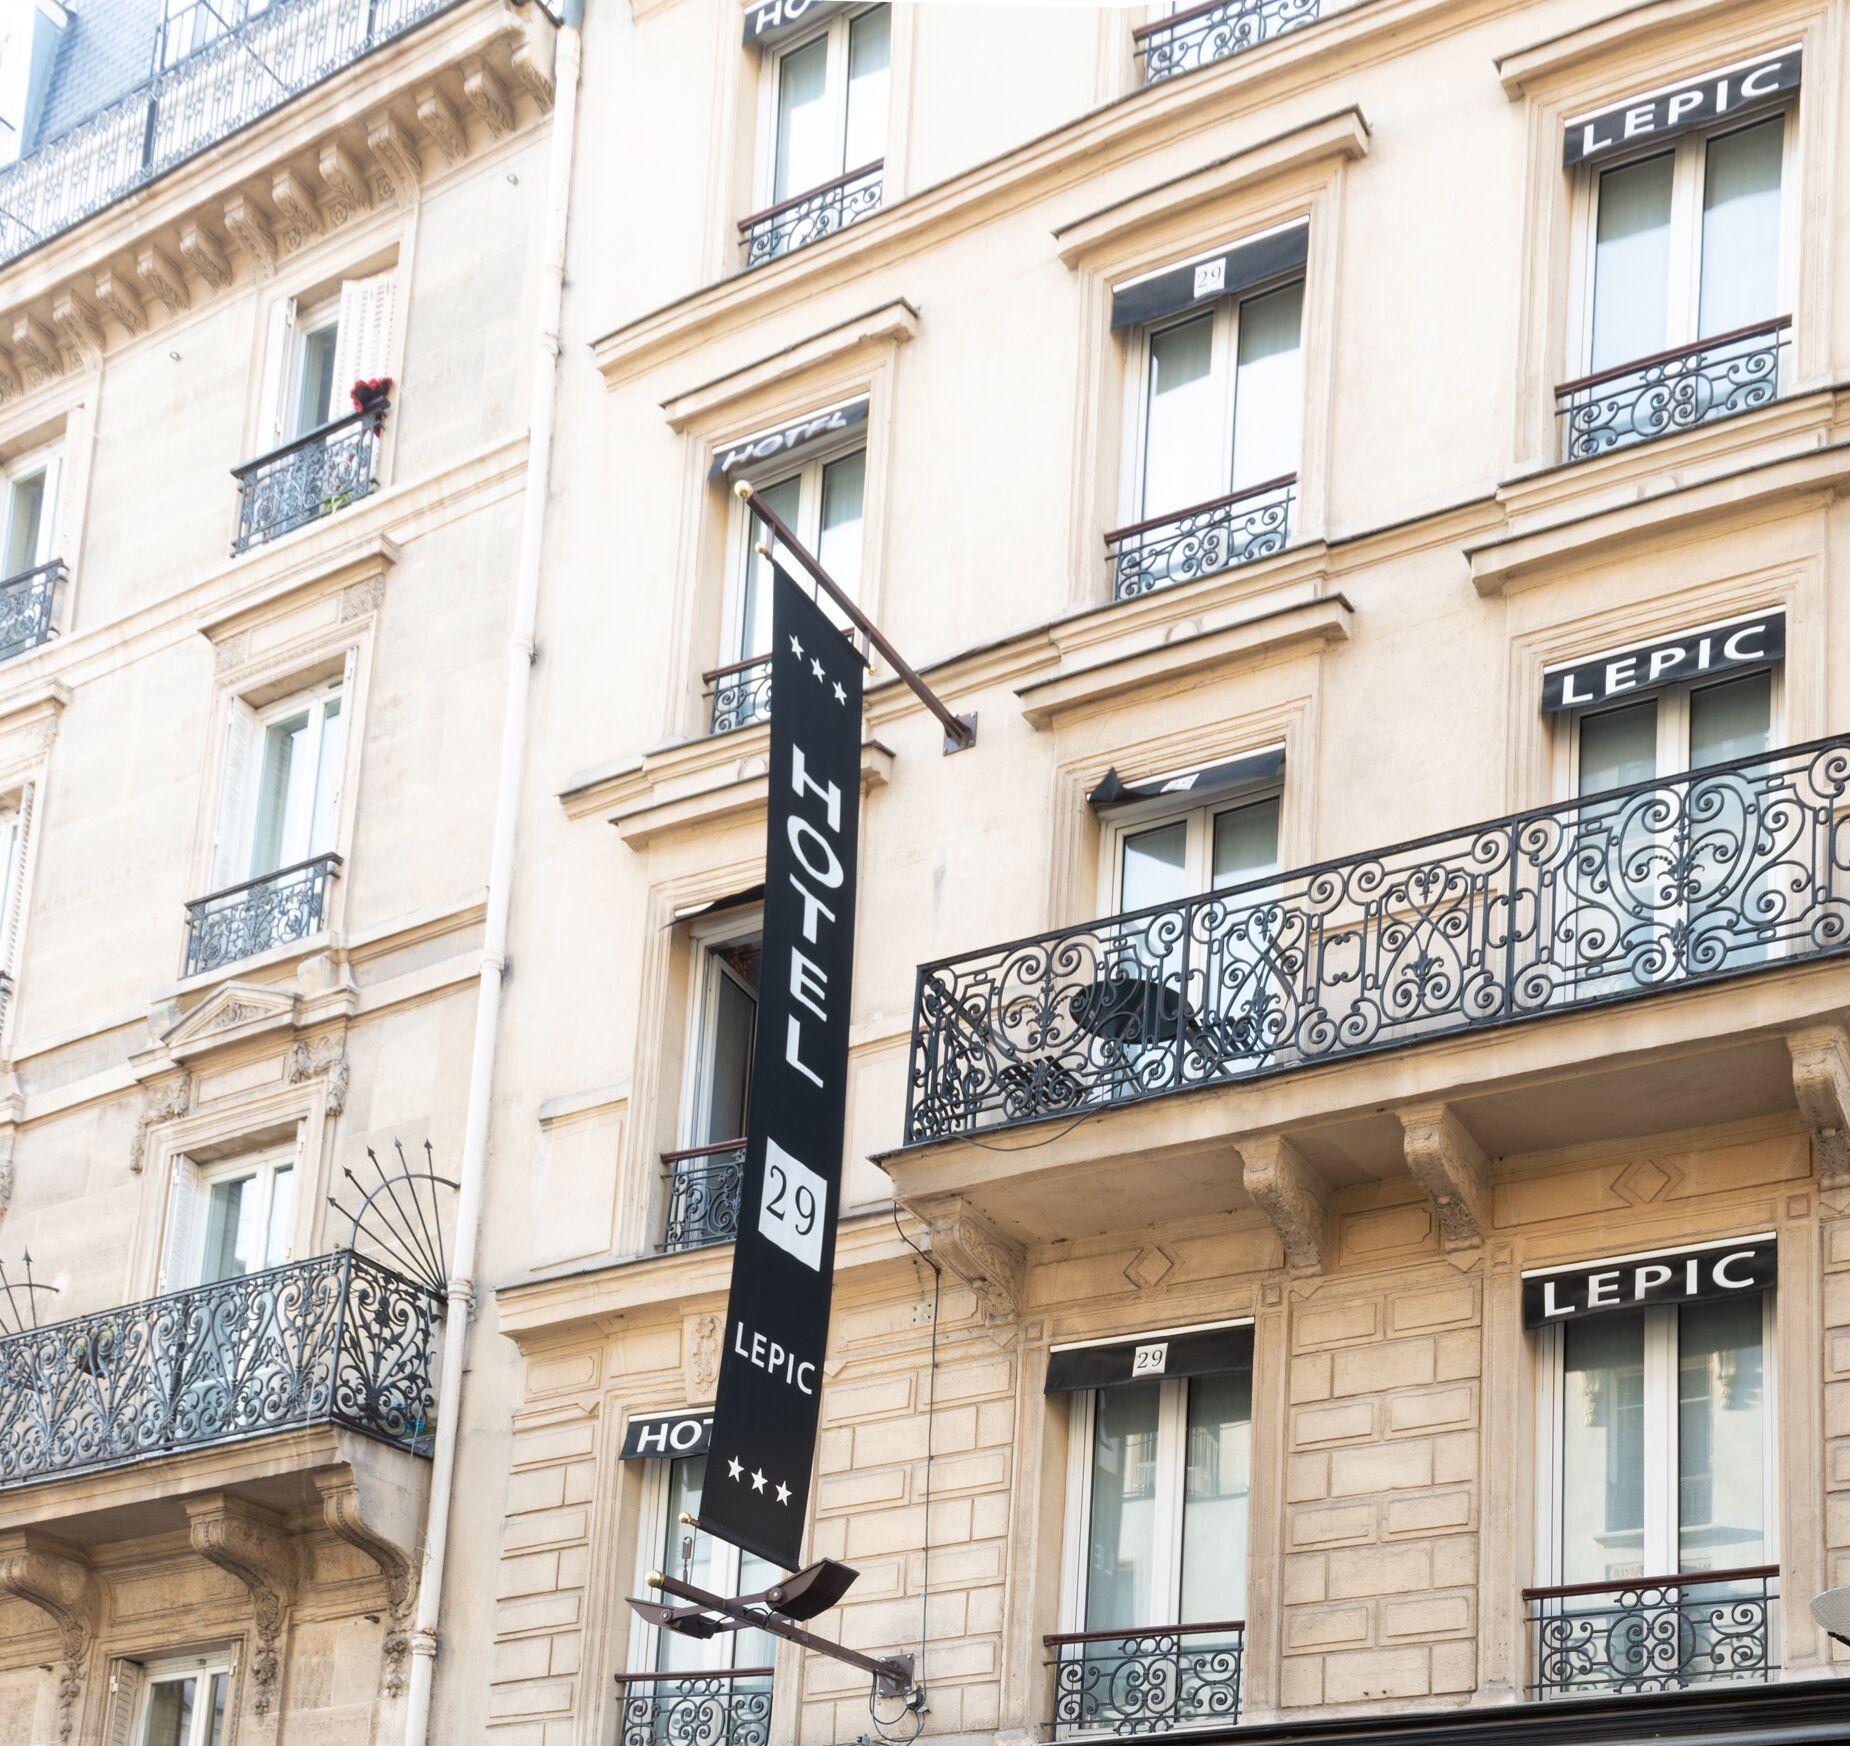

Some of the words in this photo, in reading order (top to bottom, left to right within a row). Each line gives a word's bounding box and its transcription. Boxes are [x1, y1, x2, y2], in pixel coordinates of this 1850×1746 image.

[1582, 62, 1783, 157] LEPIC
[1196, 265, 1223, 290] 29
[1561, 624, 1766, 704] LEPIC
[787, 743, 844, 1089] HOTEL
[765, 1164, 817, 1238] 29
[1544, 1250, 1758, 1318] LEPIC
[734, 1320, 816, 1397] LEPIC
[1136, 1350, 1164, 1370] 29
